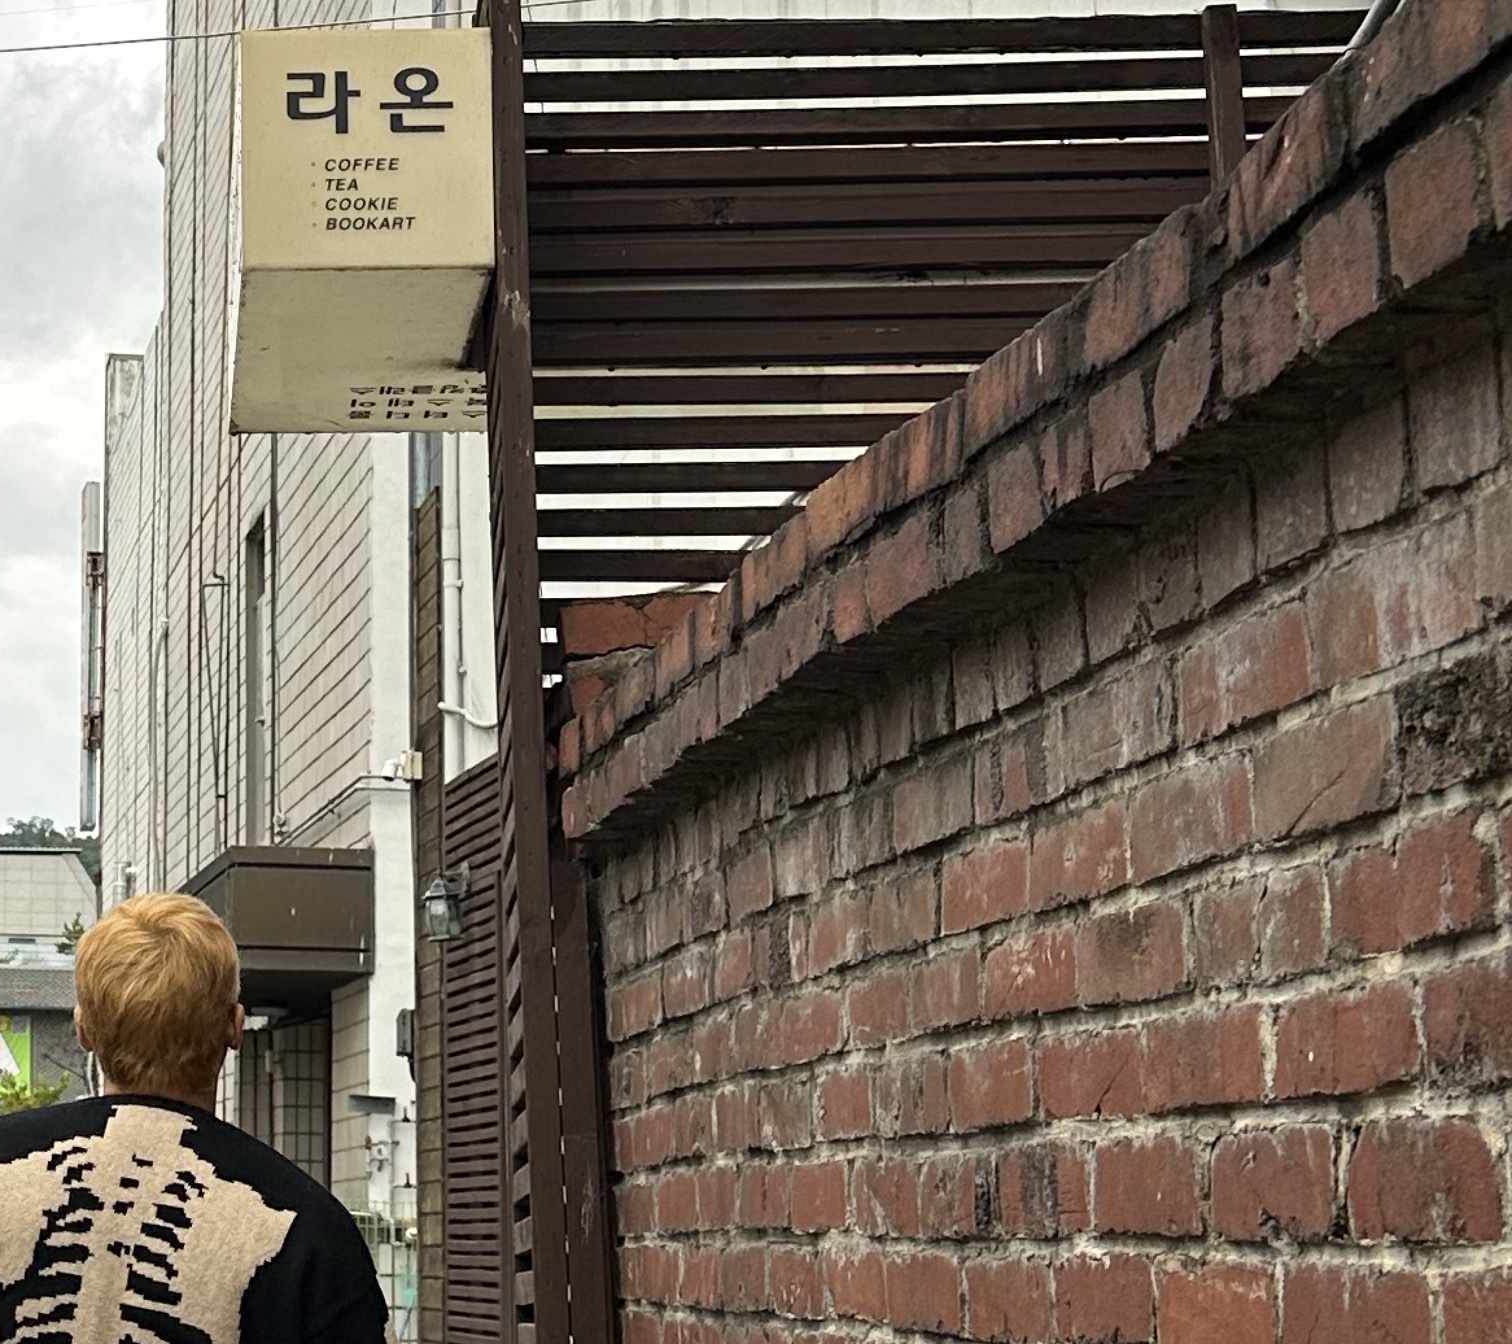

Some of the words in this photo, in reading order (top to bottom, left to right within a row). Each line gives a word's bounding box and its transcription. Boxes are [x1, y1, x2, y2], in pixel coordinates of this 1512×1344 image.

[286, 67, 454, 134] 라온
[324, 158, 400, 172] COFFEE
[325, 178, 359, 191] TEA
[324, 197, 399, 211] COOKIE
[325, 216, 416, 231] BOOKART
